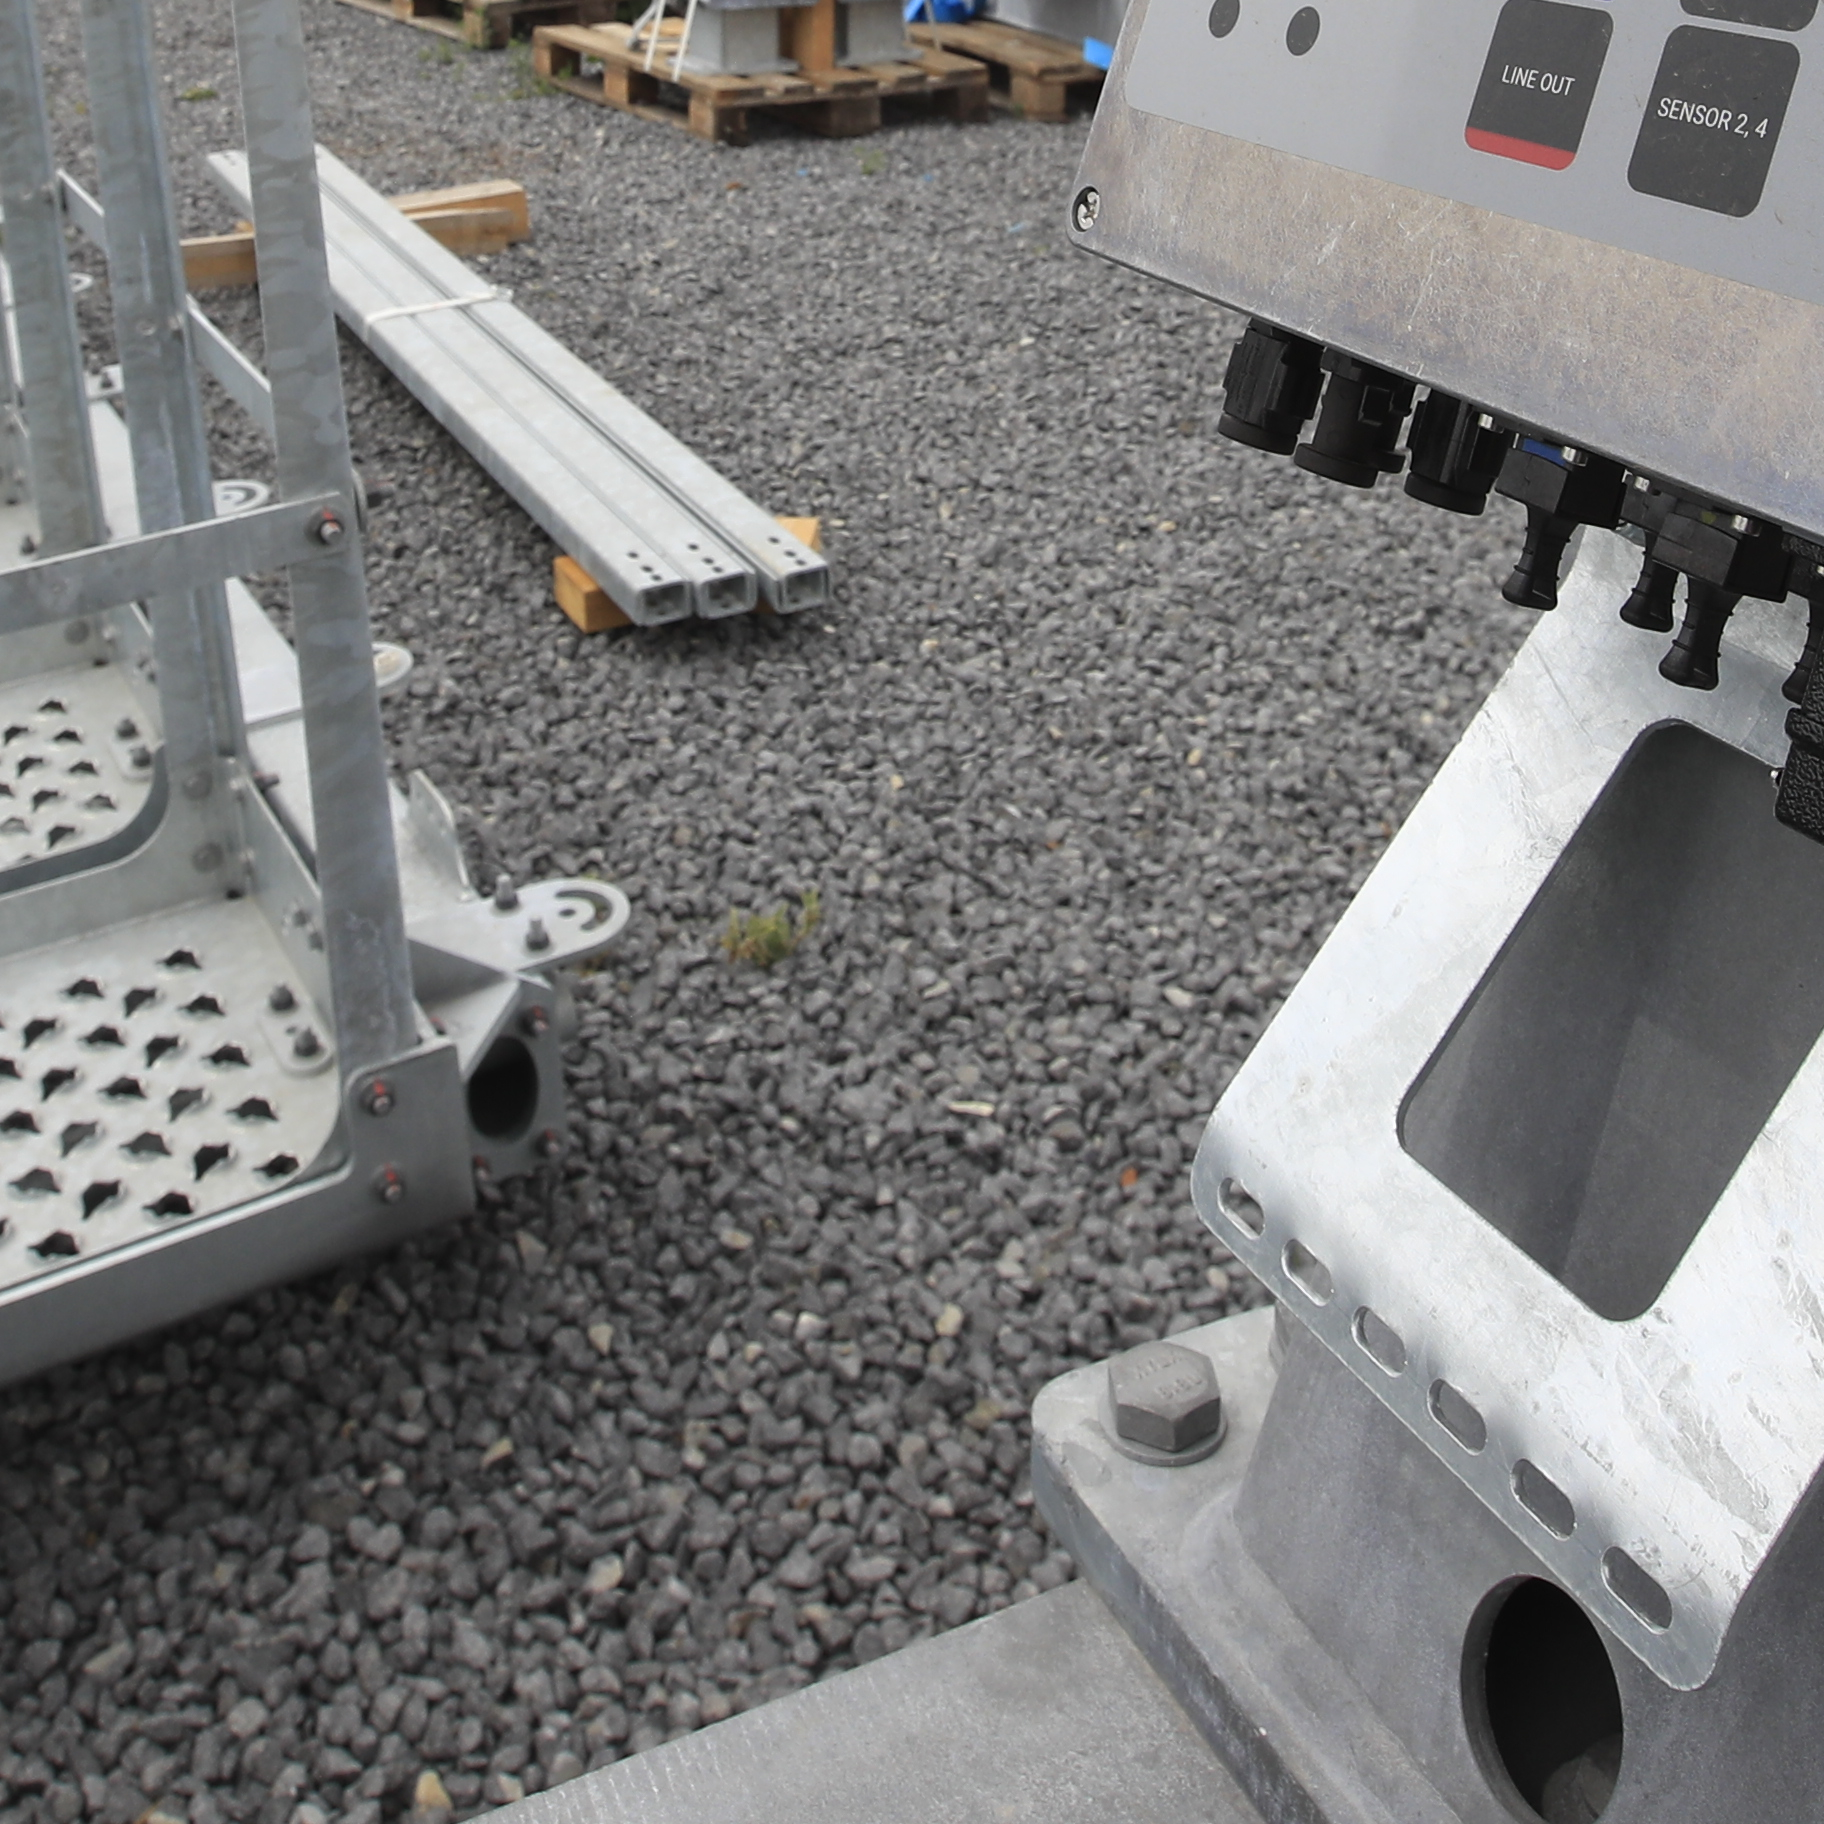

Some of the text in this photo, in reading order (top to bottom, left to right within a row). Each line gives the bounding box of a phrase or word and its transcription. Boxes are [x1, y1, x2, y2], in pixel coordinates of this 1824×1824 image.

[1501, 64, 1576, 96] LINE OUT
[1657, 97, 1769, 138] SENSOR 2, 4
